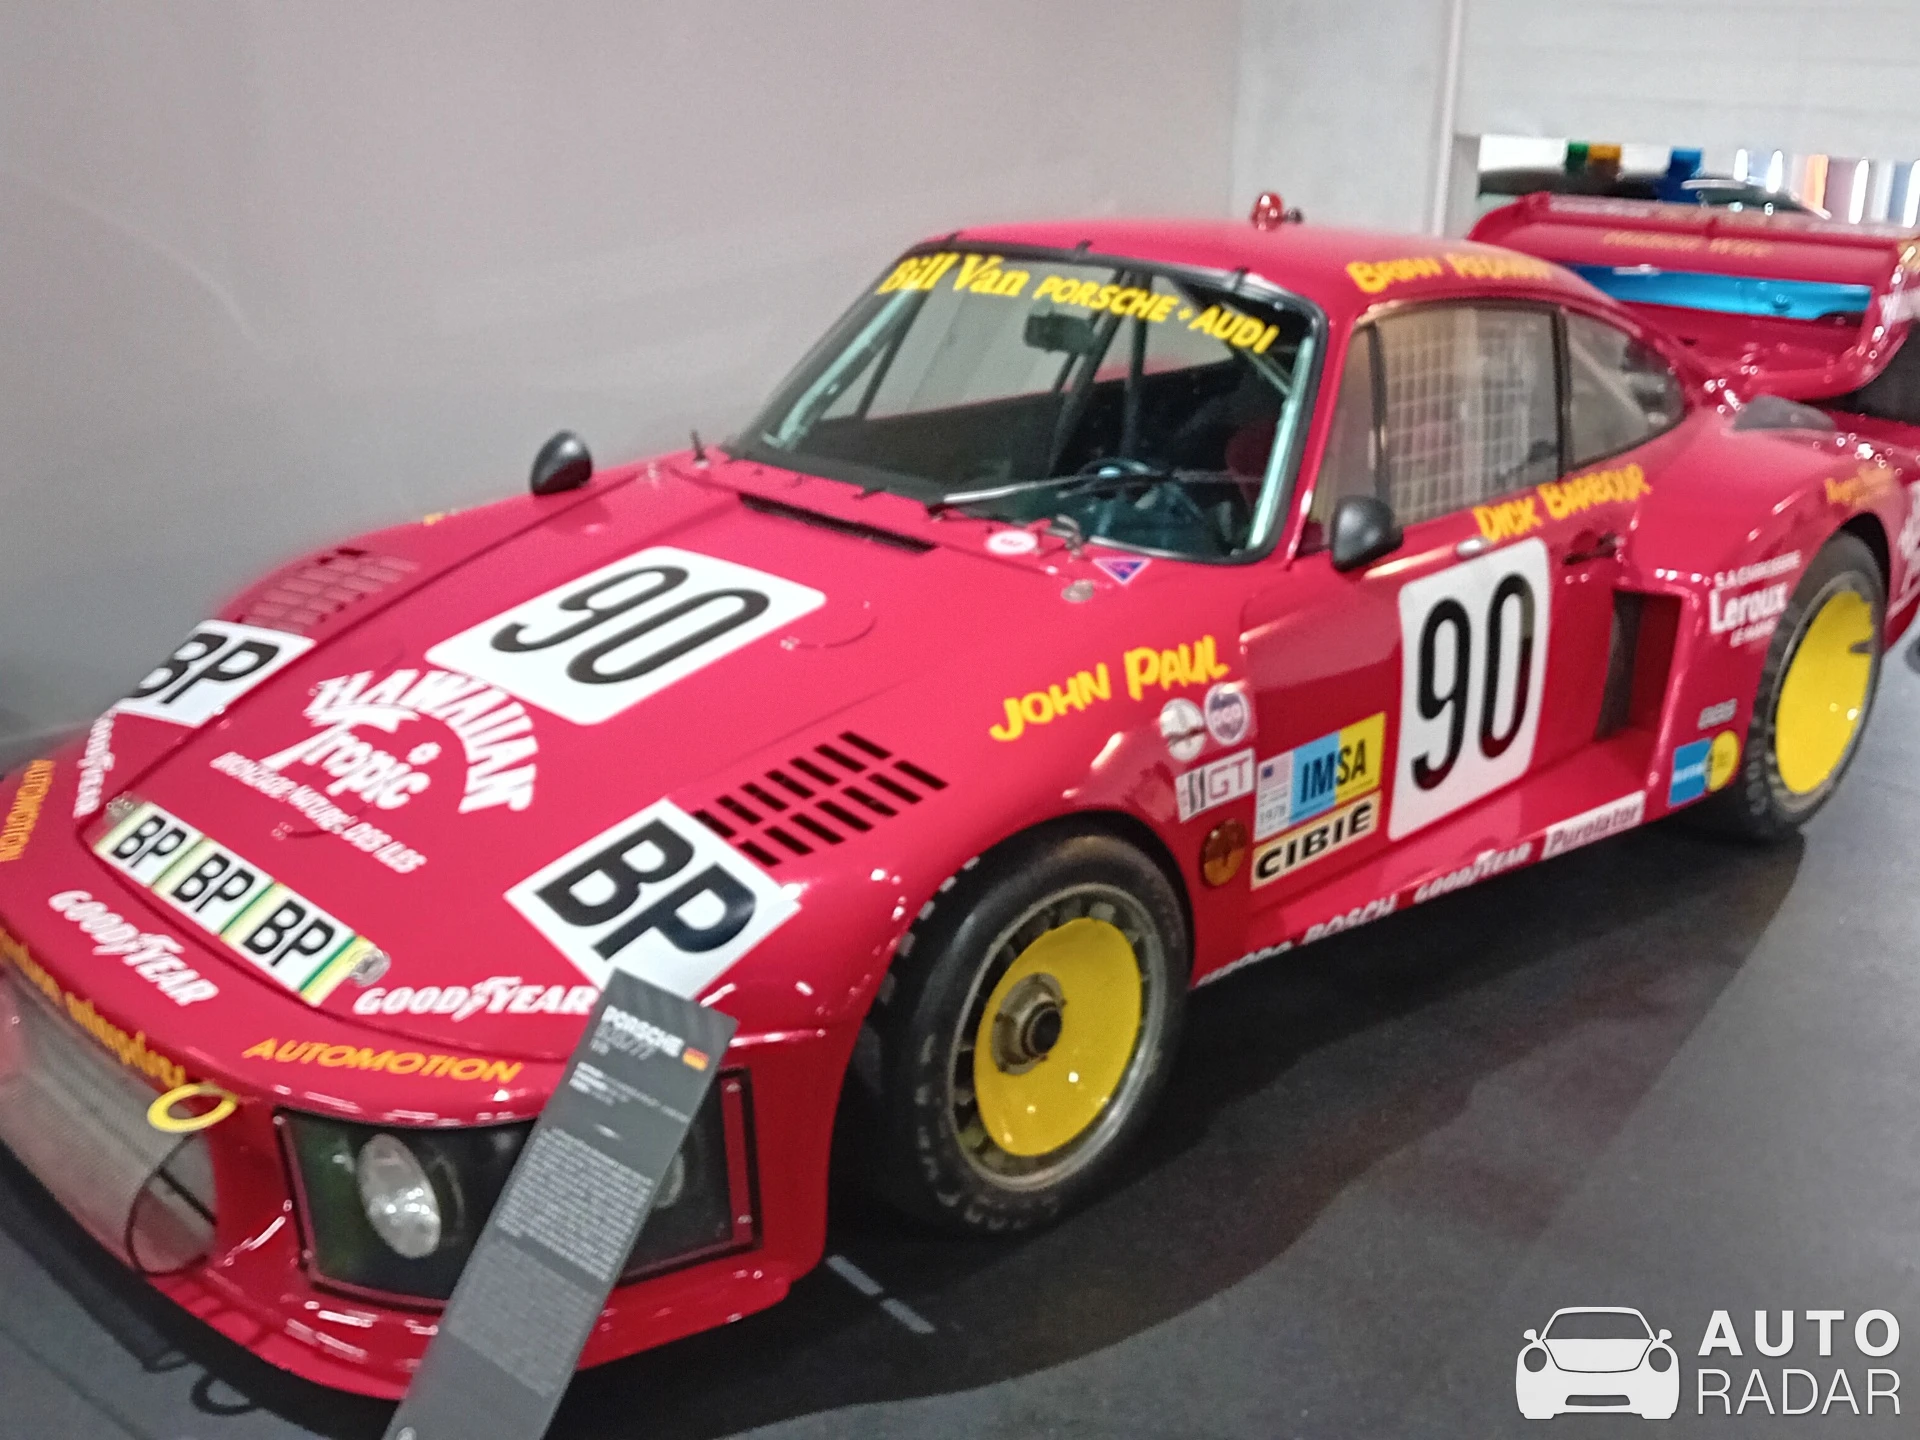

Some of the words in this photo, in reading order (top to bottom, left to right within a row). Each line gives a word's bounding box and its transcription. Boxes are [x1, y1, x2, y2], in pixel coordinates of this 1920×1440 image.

[874, 251, 960, 295] Bill
[953, 253, 1031, 297] Van
[1032, 274, 1180, 323] PORSCHE
[1188, 304, 1281, 354] AUDI
[1472, 495, 1543, 544] DICK
[489, 565, 771, 686] 90
[989, 662, 1112, 742] JOHN
[1123, 634, 1231, 701] PAUL
[1410, 572, 1536, 790] 90
[258, 706, 441, 811] Tropic
[302, 668, 540, 814] HAWAIIAN
[1208, 754, 1252, 800] GT
[1300, 738, 1368, 804] IMSA
[112, 815, 187, 869] BP
[173, 853, 254, 913] BP
[534, 817, 757, 962] BP
[48, 889, 220, 1007] GOODYEAR
[243, 900, 336, 966] BP
[353, 976, 600, 1022] GOODYEAR
[242, 1037, 523, 1083] AUTOMOTION
